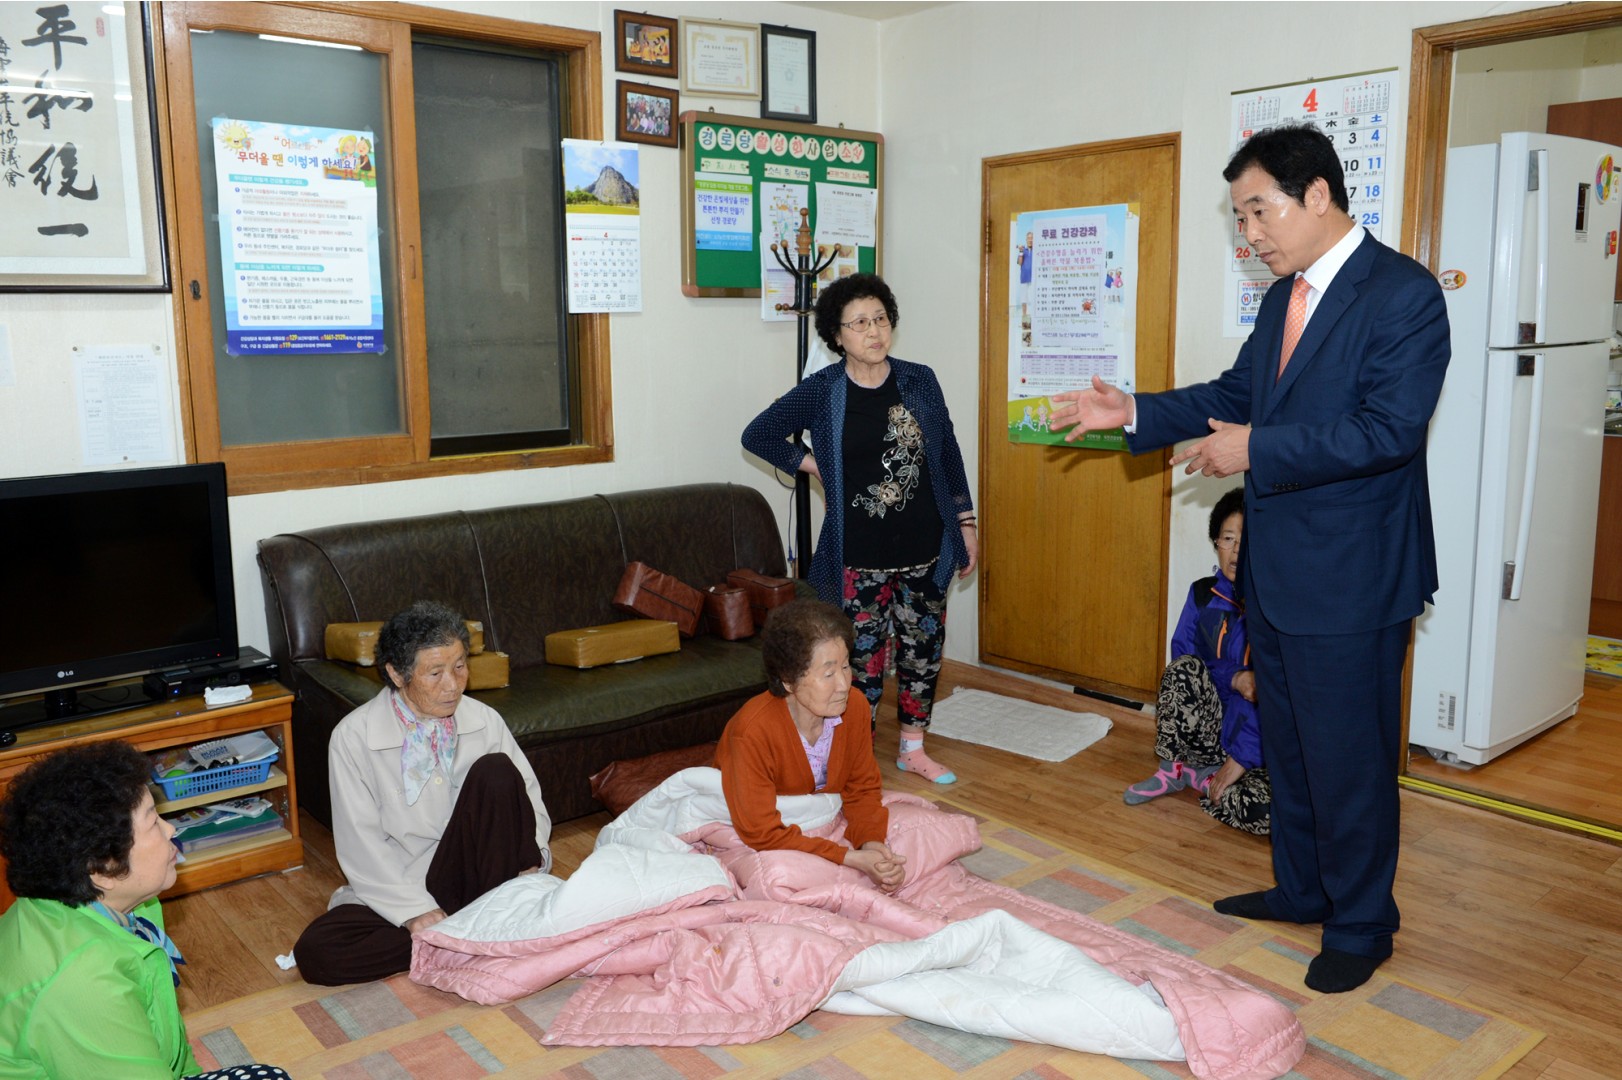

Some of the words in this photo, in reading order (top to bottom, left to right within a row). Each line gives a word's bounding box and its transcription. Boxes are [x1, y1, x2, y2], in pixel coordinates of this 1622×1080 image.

[1302, 88, 1318, 112] 4
[1370, 113, 1382, 123] 土
[702, 130, 751, 150] 경로당
[1348, 131, 1358, 144] 3
[1371, 129, 1381, 142] 4
[238, 152, 269, 166] 무더울
[272, 152, 283, 168] 땐
[287, 154, 318, 170] 이렇게
[322, 156, 357, 169] 하세요!
[1343, 159, 1359, 172] 10
[1367, 156, 1381, 170] 11
[1348, 186, 1357, 199] 7
[1365, 184, 1380, 198] 18
[697, 193, 713, 203] 건강한
[739, 197, 749, 206] 위한
[730, 207, 745, 216] 만들기
[722, 217, 737, 226] 경로당
[1362, 212, 1380, 226] 25
[1041, 229, 1057, 240] 무료
[1061, 226, 1098, 239] 건강강좌
[1235, 246, 1251, 259] 26
